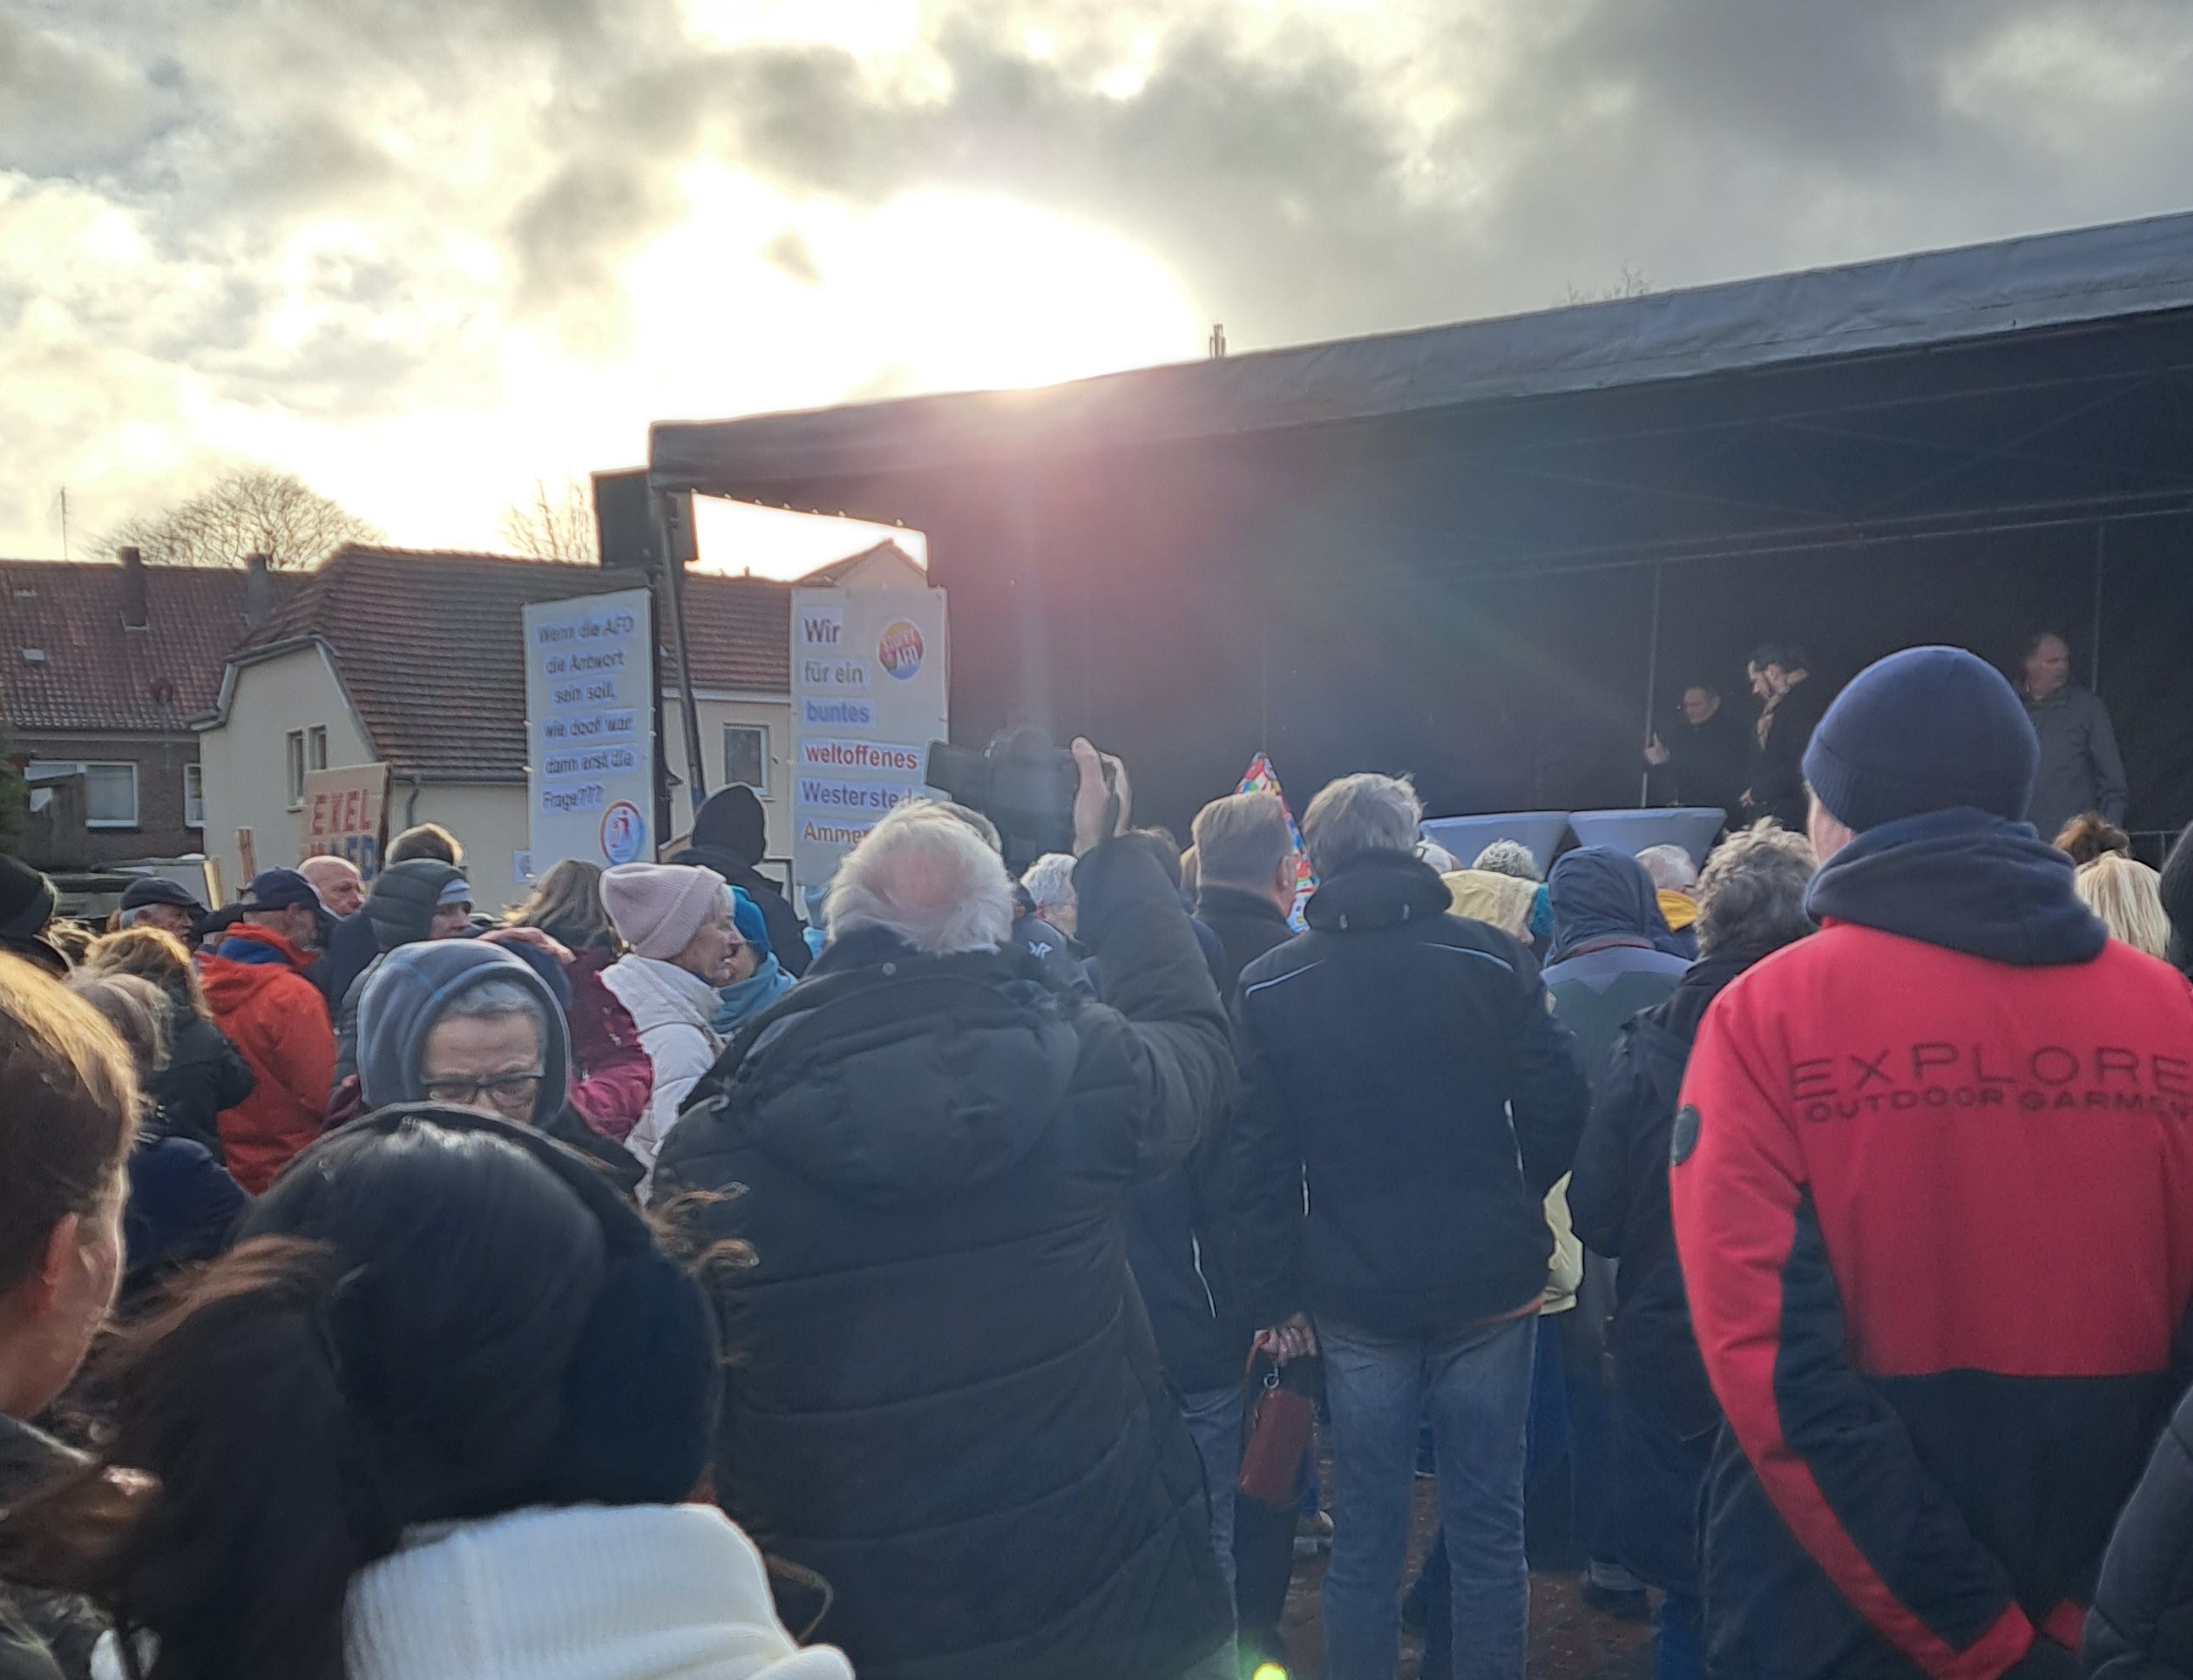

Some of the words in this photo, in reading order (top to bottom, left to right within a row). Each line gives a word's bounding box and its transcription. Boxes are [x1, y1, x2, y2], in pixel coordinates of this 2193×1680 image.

[578, 619, 600, 638] die
[804, 617, 841, 644] Wir
[545, 655, 566, 674] die
[569, 649, 625, 671] Antwort
[804, 660, 830, 682] für
[835, 660, 864, 684] ein
[555, 684, 583, 705] sein
[806, 700, 870, 724] buntes
[544, 720, 566, 738] wie
[570, 716, 601, 737] doof
[605, 717, 633, 732] war
[545, 757, 578, 775] dann
[582, 752, 609, 771] erst
[611, 749, 634, 767] die
[805, 741, 918, 770] weltoffenes
[1788, 1042, 2190, 1101] EXPLORE
[1806, 1086, 2004, 1124] OUTDOOR
